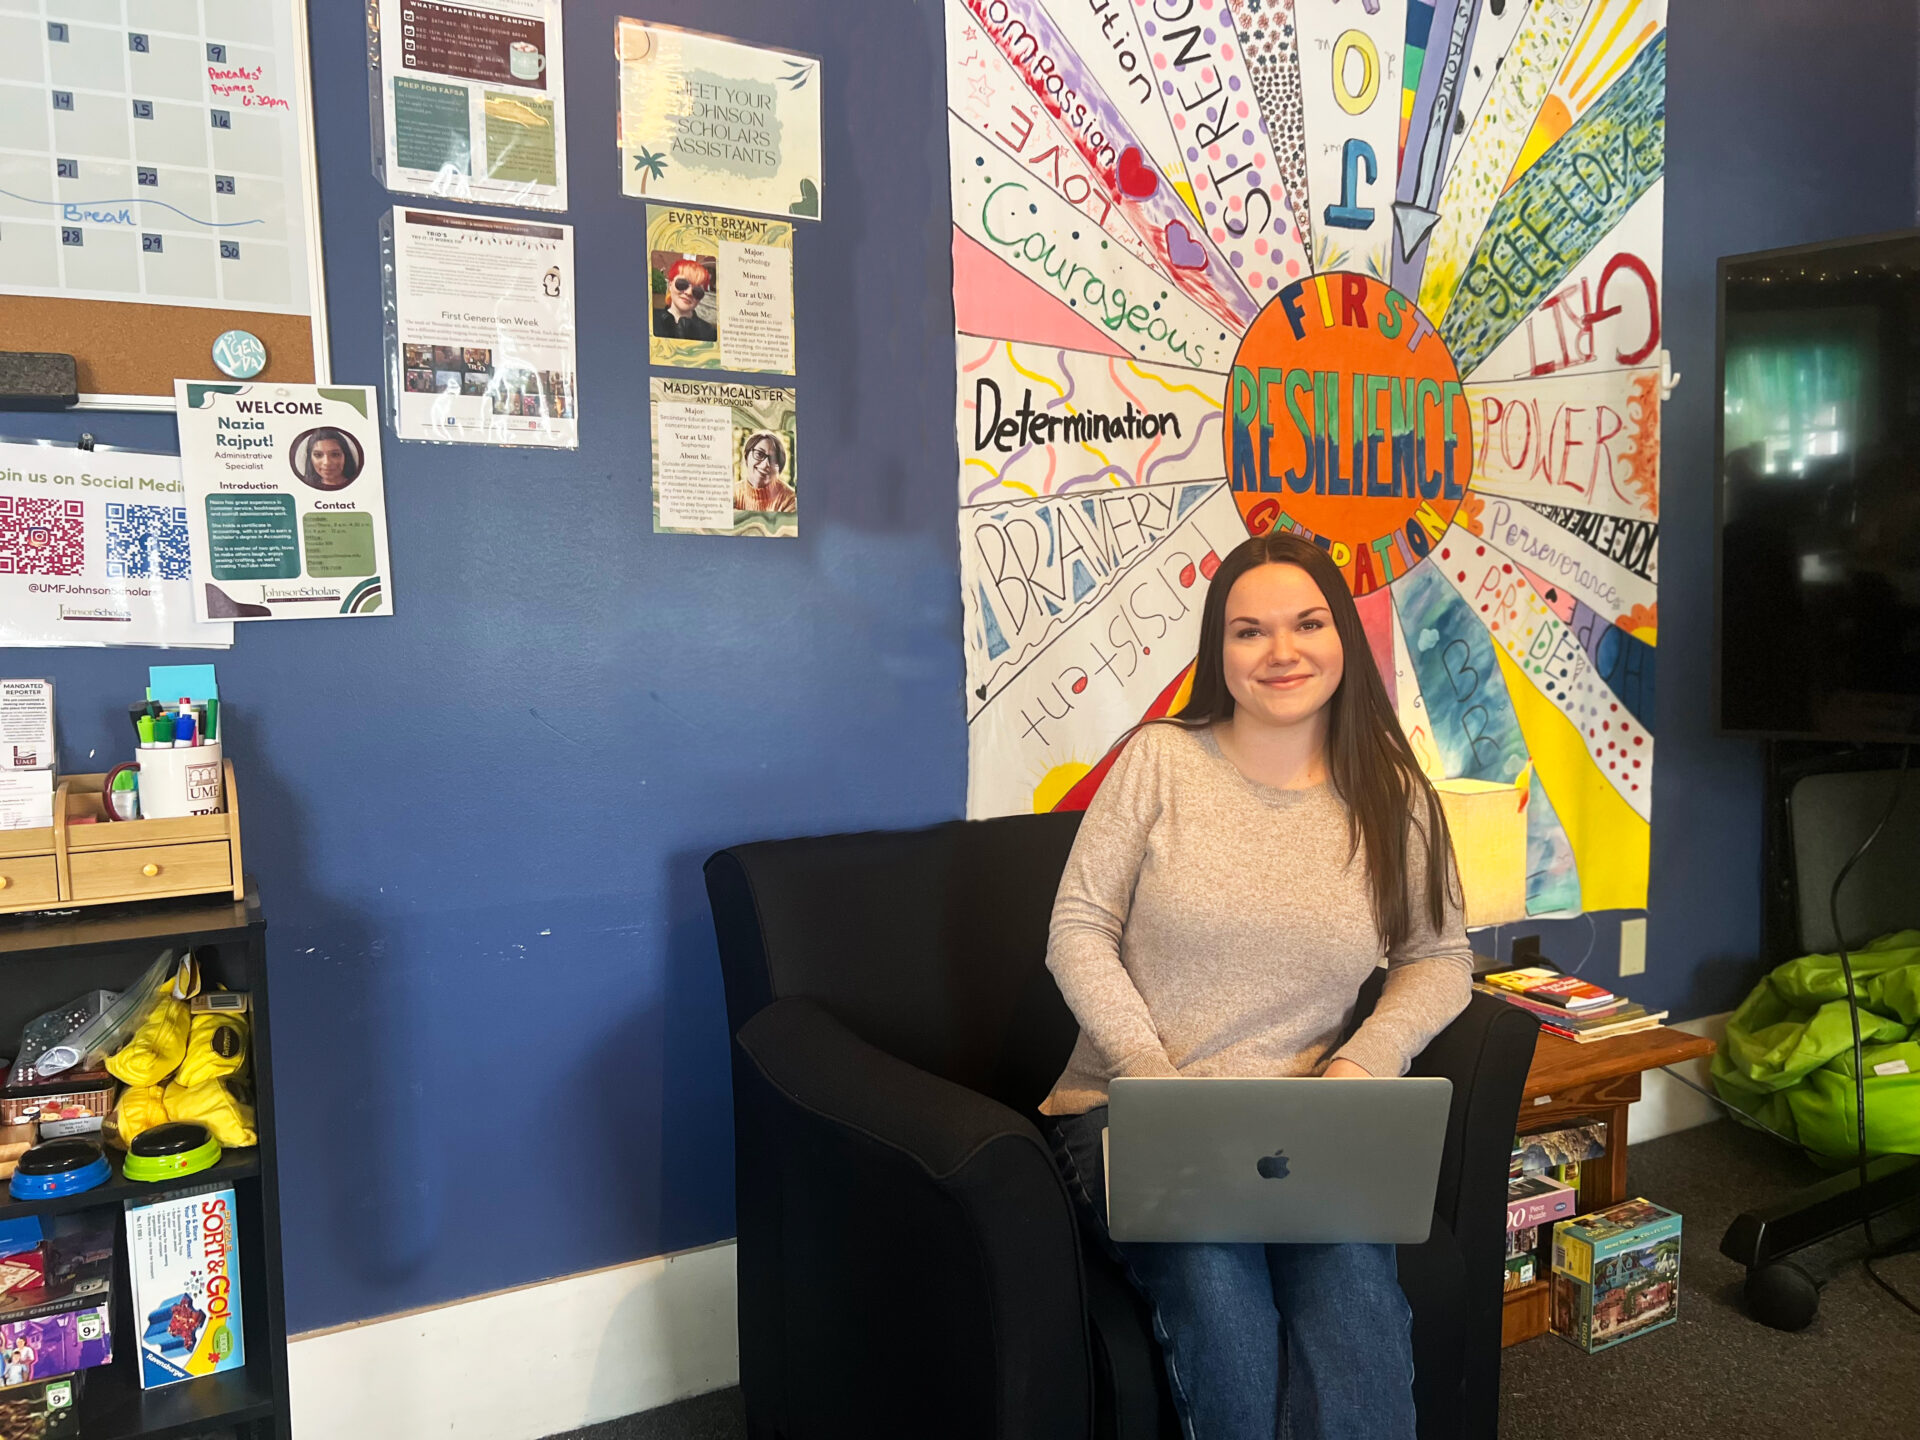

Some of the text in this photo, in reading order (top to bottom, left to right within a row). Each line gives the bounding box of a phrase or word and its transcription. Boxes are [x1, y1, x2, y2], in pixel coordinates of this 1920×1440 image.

[410, 1, 440, 11] WHAT'S
[442, 6, 486, 19] HAPPENING
[50, 24, 64, 40] 7
[134, 35, 147, 52] 8
[210, 46, 223, 62] 9
[398, 80, 465, 97] PREP FOR FAFSA
[681, 79, 772, 111] EET YOUR
[54, 93, 71, 108] 14
[134, 102, 151, 117] 15
[213, 112, 229, 128] 16
[678, 120, 771, 147] SCHOLARS
[672, 137, 776, 166] ASSISTANTS
[57, 163, 73, 178] 21
[996, 104, 1112, 226] LOVE
[137, 172, 158, 186] 22
[216, 180, 234, 193] 23
[63, 204, 137, 226] Break
[669, 212, 768, 234] EVRYST BRYANT
[1465, 122, 1664, 318] SELF LOVE
[62, 228, 80, 243] 28
[696, 226, 746, 240] THEY/THEM
[142, 235, 162, 250] 29
[220, 244, 240, 258] 30
[982, 182, 1205, 368] Courageous
[441, 311, 539, 327] First Generaion Week
[1278, 274, 1434, 353] FIRST
[1514, 252, 1660, 380] GRIT
[663, 382, 784, 402] MADISYN MCALISTER
[236, 400, 323, 415] WELCOME
[696, 396, 754, 407] ANY PRONOUNS
[975, 377, 1181, 452] Determination
[218, 417, 265, 431] Nazia
[1231, 365, 1463, 500] RESILIENCE
[216, 434, 274, 450] Rajput!
[214, 451, 273, 460] Administrative
[1480, 397, 1630, 506] POWER
[225, 462, 264, 471] Specialist
[28, 473, 47, 483] us
[53, 474, 74, 486] on
[81, 474, 134, 490] Social
[219, 482, 279, 490] Introduction
[314, 501, 356, 509] Contact
[974, 487, 1176, 635] BRAVERY
[259, 584, 341, 604] JohnsonScholars
[190, 785, 219, 799] UMF
[223, 1210, 233, 1252] PUZZLE
[202, 1199, 232, 1321] SORT & GO!
[82, 1327, 97, 1337] 9+
[146, 1353, 186, 1379] Ravensburger
[53, 1395, 66, 1405] 9+
